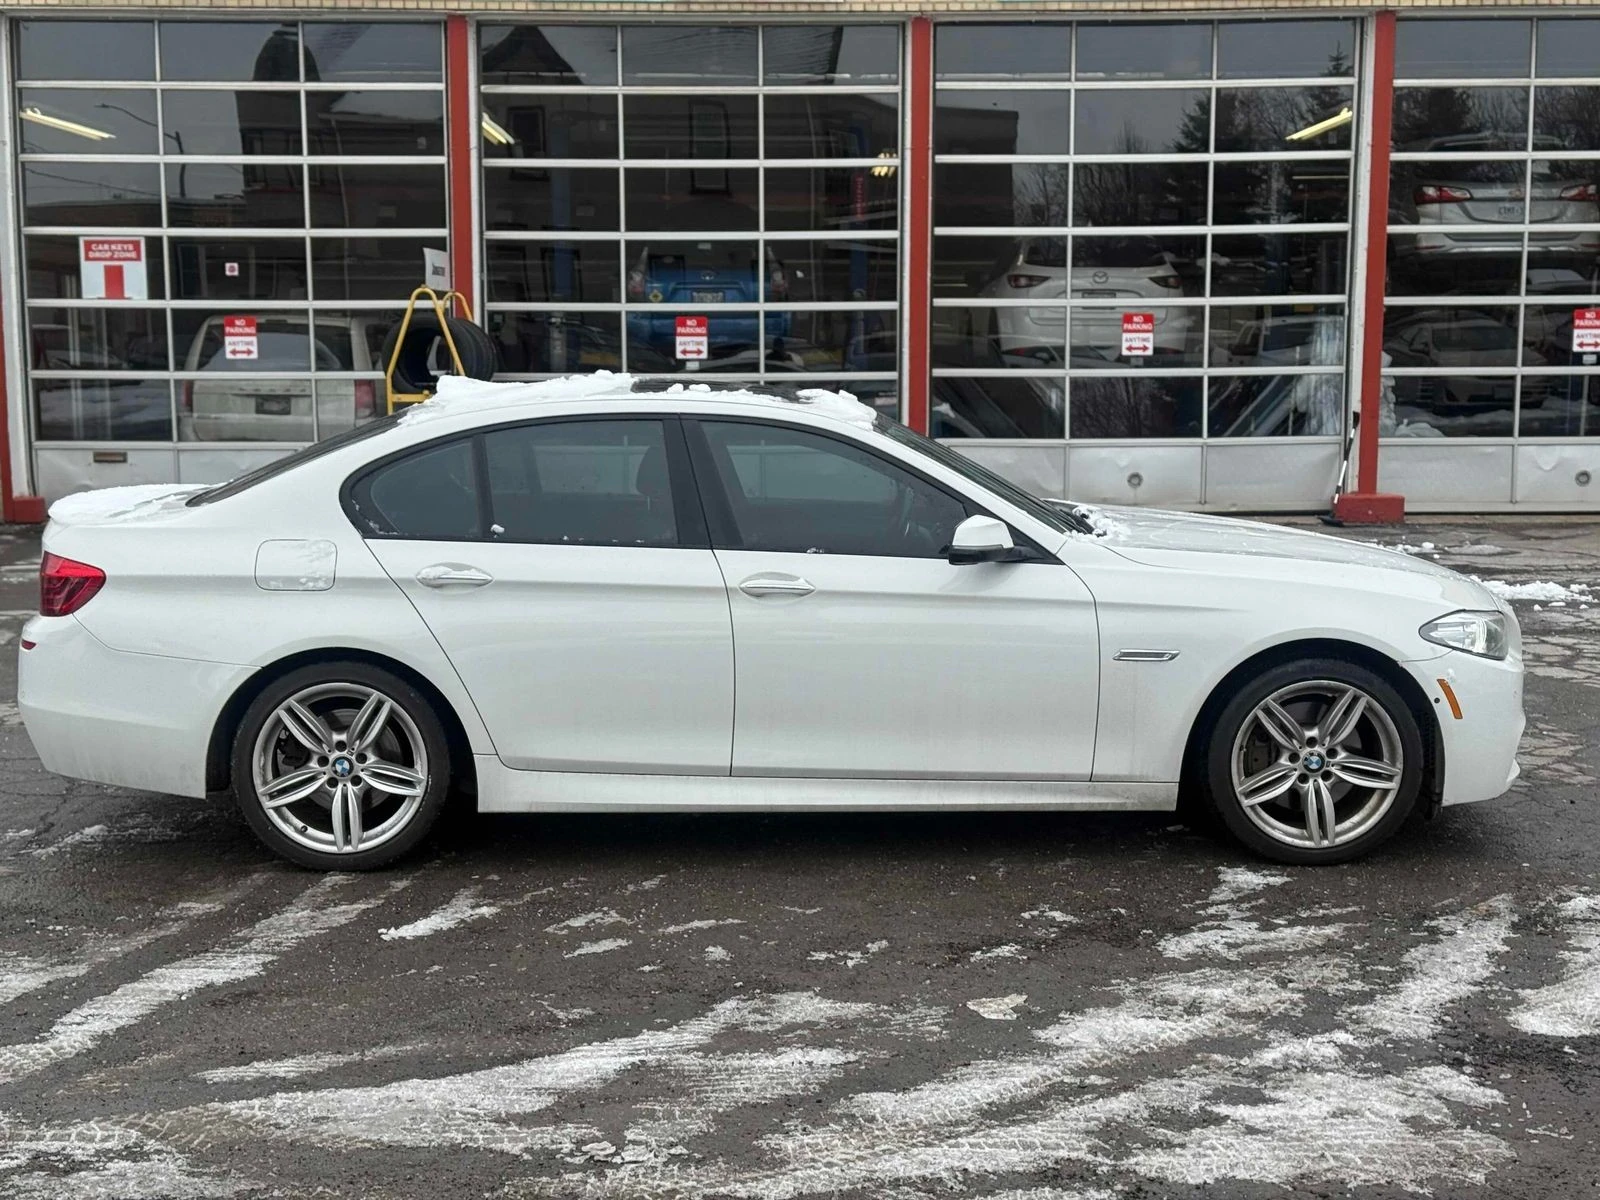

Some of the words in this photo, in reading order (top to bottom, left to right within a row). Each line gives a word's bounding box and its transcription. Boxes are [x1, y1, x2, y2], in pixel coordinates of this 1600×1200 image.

[91, 243, 109, 251] CAR
[110, 243, 134, 251] KEYS
[113, 251, 137, 259] ZONE
